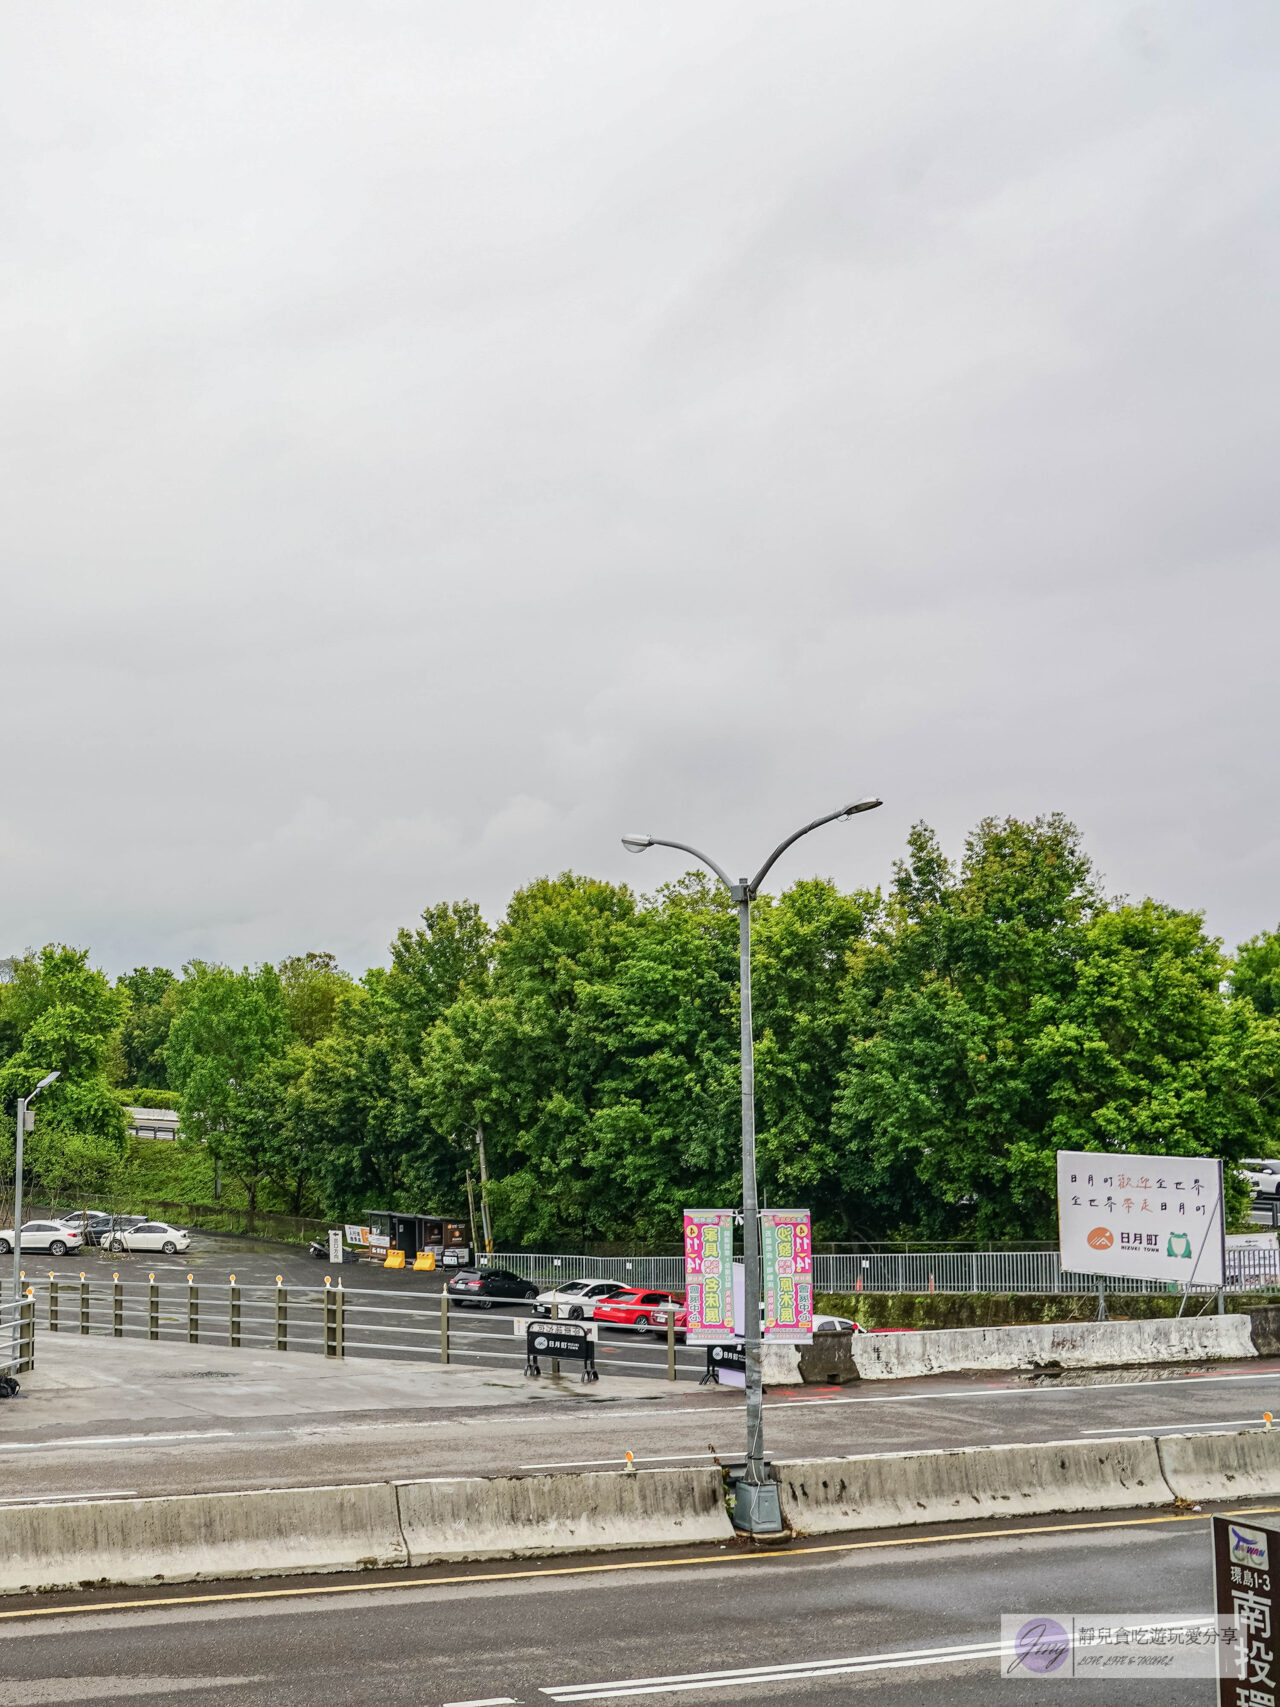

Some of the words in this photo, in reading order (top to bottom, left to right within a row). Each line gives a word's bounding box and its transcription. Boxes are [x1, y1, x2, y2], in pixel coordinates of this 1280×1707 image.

[1120, 1232, 1159, 1246] 日月町
[1230, 1566, 1271, 1592] 環島1-3
